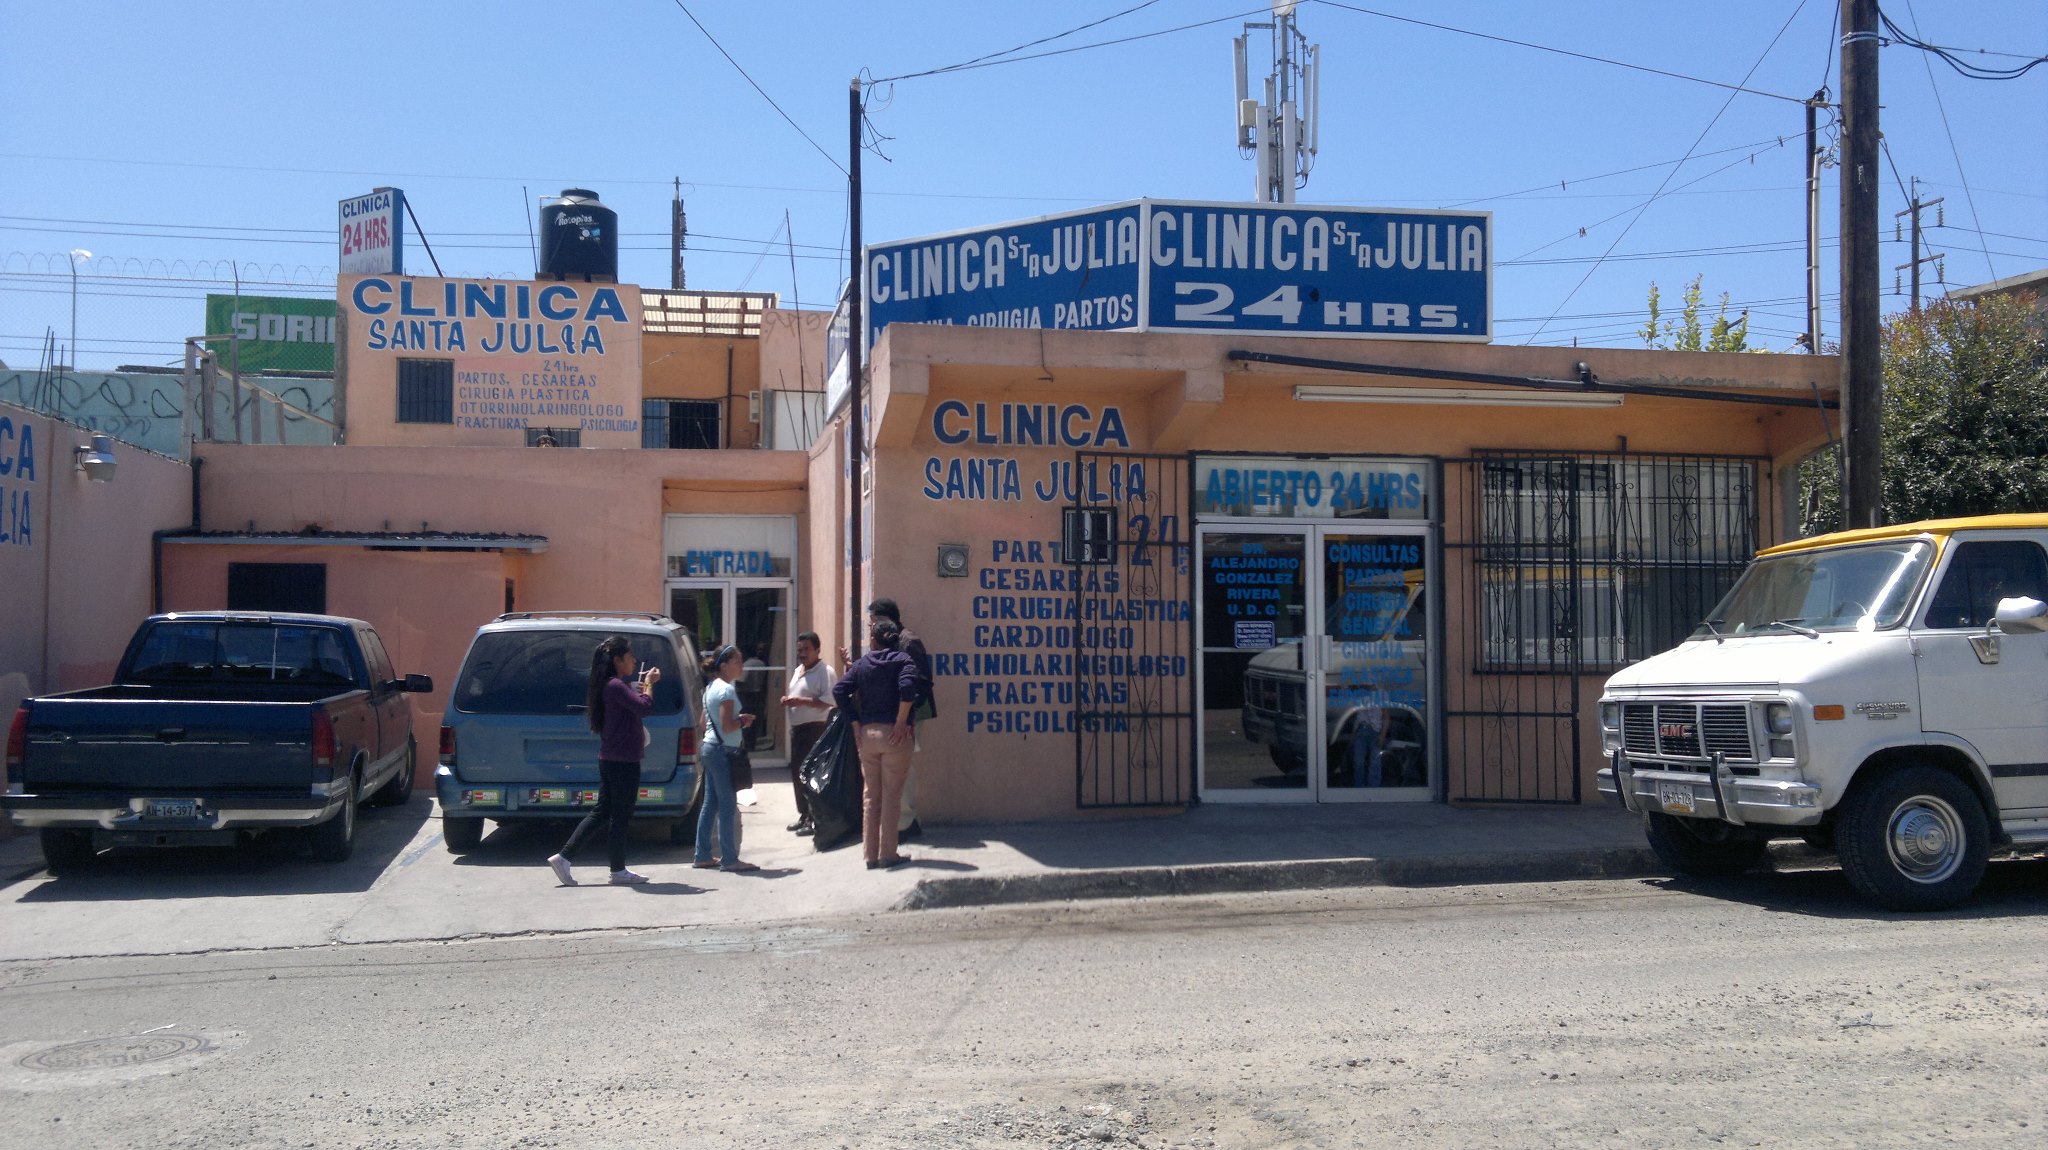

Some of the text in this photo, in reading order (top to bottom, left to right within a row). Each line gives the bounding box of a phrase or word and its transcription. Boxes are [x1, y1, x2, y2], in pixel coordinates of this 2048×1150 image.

[342, 194, 391, 218] CLINICA
[343, 216, 390, 256] 24 HRS.
[1151, 211, 1328, 271] CLINICA
[1375, 222, 1482, 271] JULIA
[871, 235, 1005, 304] CLINICA
[1042, 216, 1137, 275] JULIA
[353, 278, 629, 324] CLINICA
[1055, 293, 1133, 329] PARTOS
[1175, 282, 1469, 329] 24 HRS.
[367, 319, 606, 356] SANTA JULIA
[544, 359, 579, 373] 24 hrs
[522, 373, 597, 388] CESAREAS
[459, 387, 590, 401] CIRUGIA PLASTICA
[461, 402, 624, 417] OTORRINOLARINGOLOGO
[457, 417, 638, 432] FRACTURAS PSICOLOGIA
[932, 400, 1130, 448] CLINICA
[923, 456, 1147, 503] SANTA JULIA
[1206, 468, 1422, 509] ABIERTO 24 HRS
[1129, 513, 1179, 567] 24
[1242, 543, 1267, 556] DR.
[687, 550, 772, 575] ENTRADA
[1210, 557, 1299, 570] ALEJANDRO
[1329, 544, 1419, 563] CONSULTAS
[979, 568, 1121, 593] CESAREAS
[1215, 572, 1294, 585] GONZALEZ
[1345, 568, 1405, 587] PARTOS
[1227, 588, 1281, 600] RIVERA
[1345, 591, 1407, 612] CIRUGIA
[973, 595, 1191, 622] CIRUGIA PLASTICA
[975, 625, 1135, 648] CARDIOLOGO
[1342, 616, 1412, 636] GENERAL
[1342, 640, 1405, 660] CIRUGIA
[969, 682, 1129, 705] FRACTURAS
[967, 709, 1130, 734] PSICOLOGIA
[1660, 724, 1692, 737] GMC
